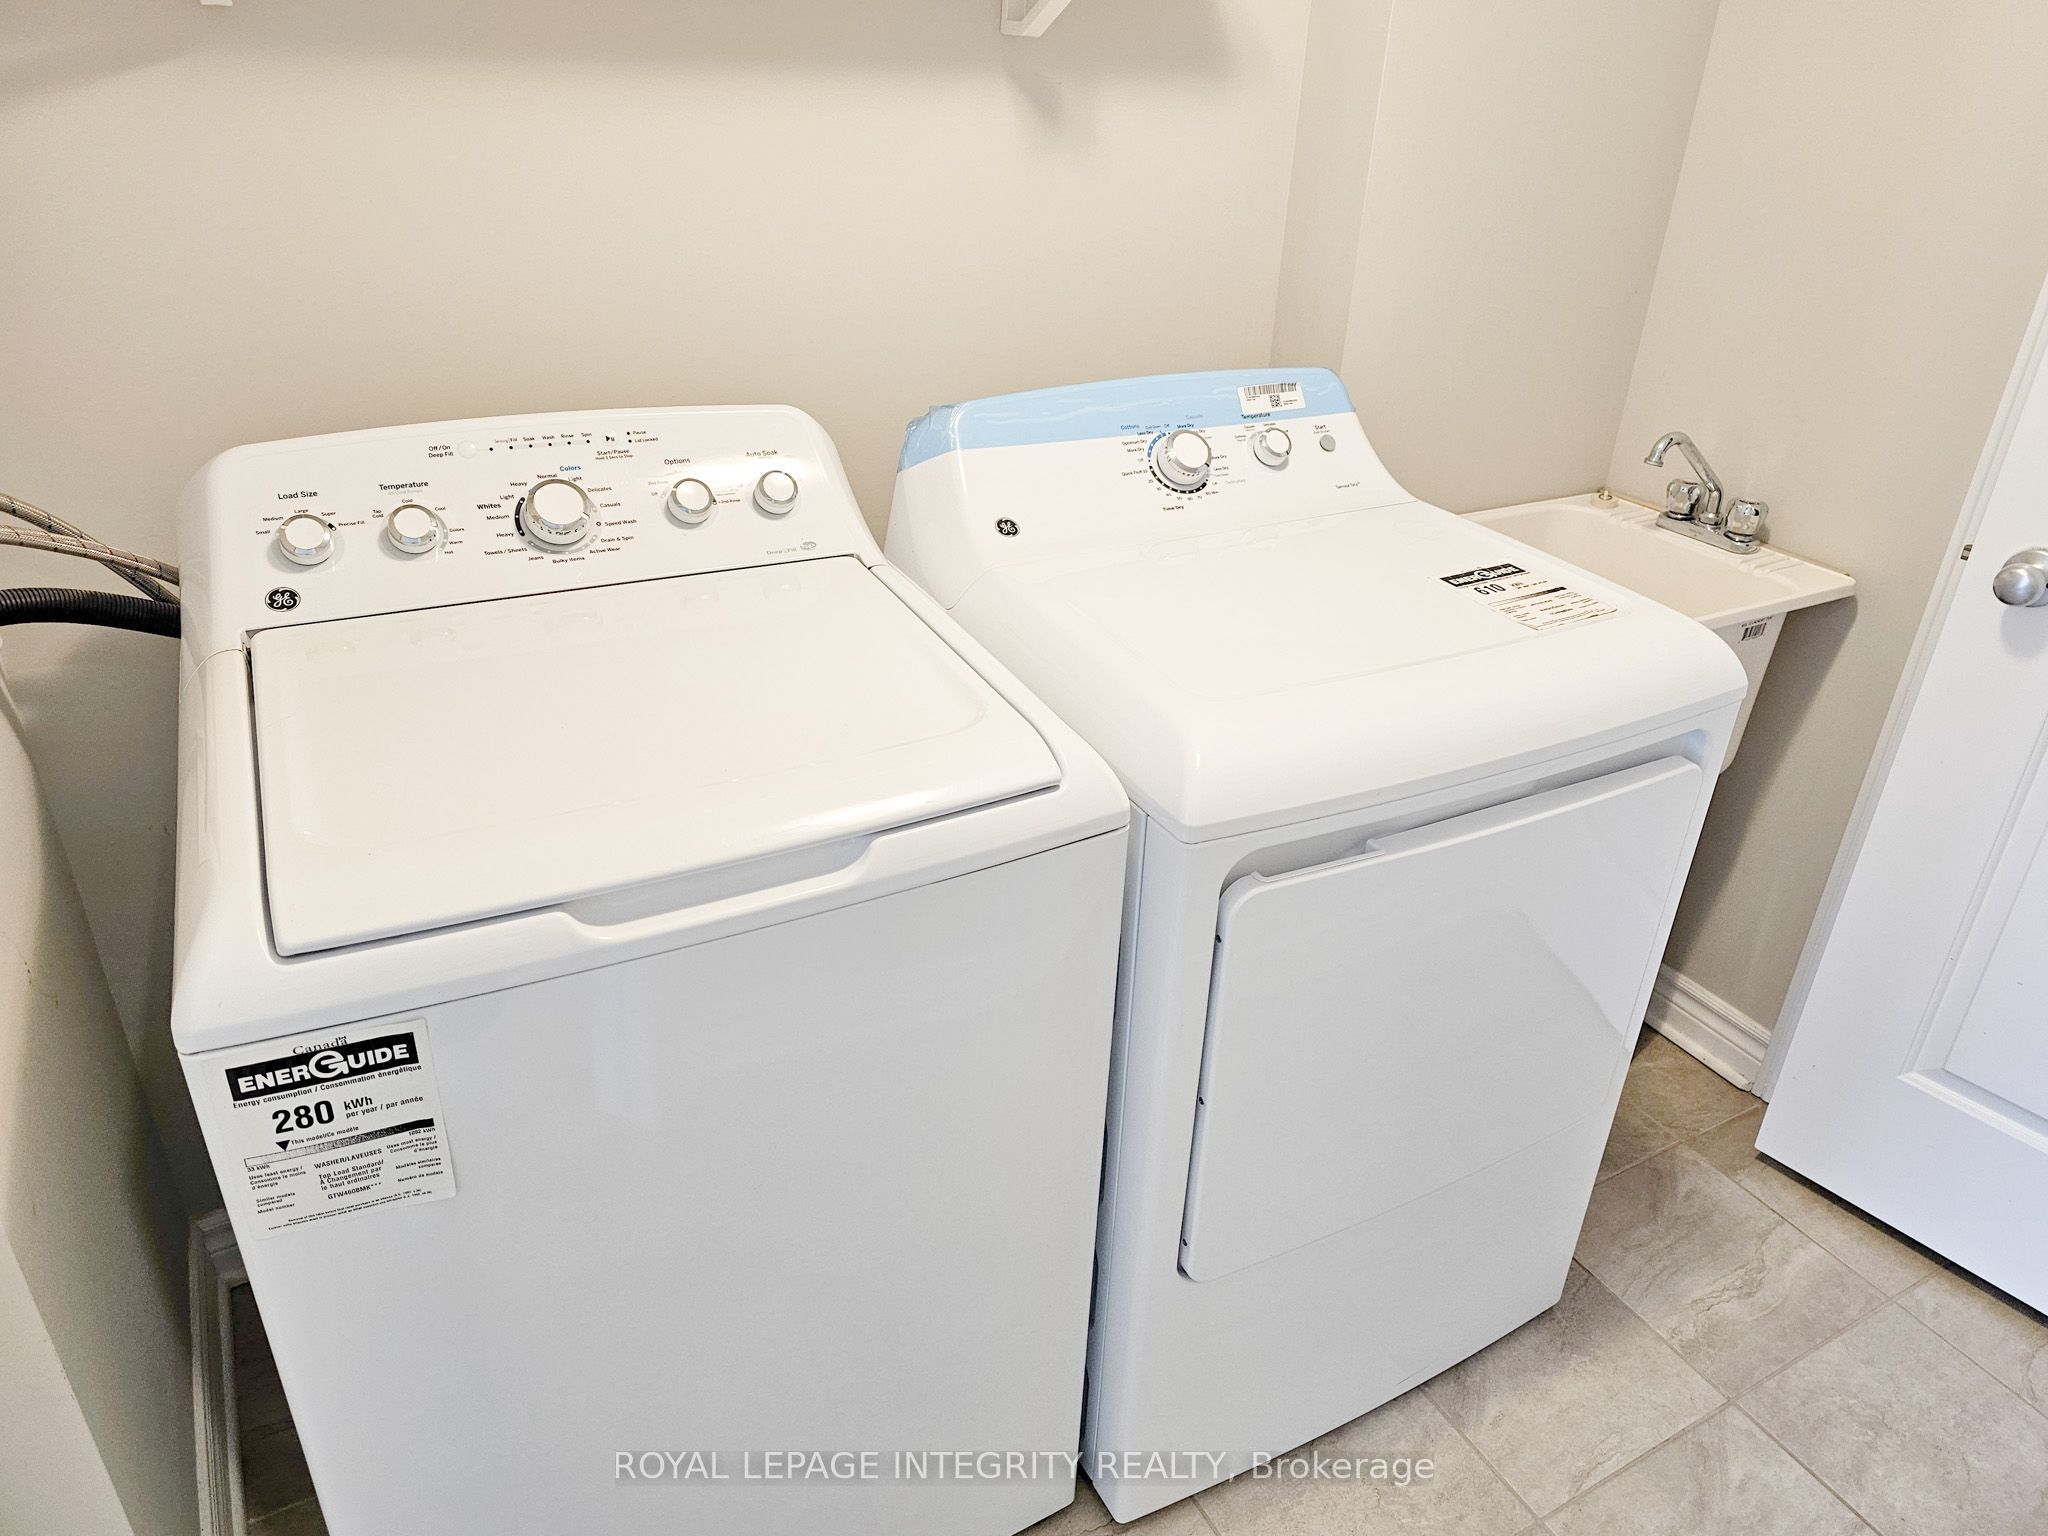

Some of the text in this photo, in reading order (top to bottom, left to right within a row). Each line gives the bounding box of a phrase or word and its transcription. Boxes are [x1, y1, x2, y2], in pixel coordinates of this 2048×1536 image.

[664, 457, 691, 466] Options
[378, 480, 429, 491] Temperature
[277, 490, 319, 500] Load Size
[1473, 584, 1506, 596] 610
[292, 1036, 348, 1055] Canada
[237, 1044, 410, 1093] ENERGUIDE
[233, 1099, 261, 1110] Energy
[263, 1087, 312, 1104] consumption
[321, 1074, 375, 1091] Consommation
[378, 1065, 422, 1079] énergétique
[344, 1096, 373, 1111] kWh
[346, 1111, 359, 1119] per
[361, 1105, 378, 1116] year
[386, 1102, 398, 1110] par
[401, 1096, 424, 1105] année
[272, 1100, 334, 1135] 280
[291, 1138, 305, 1146] This
[314, 1148, 383, 1170] WASHER/LAVEUSES
[249, 1174, 263, 1182] Uses
[264, 1170, 279, 1178] least
[257, 1164, 270, 1172] kWh
[319, 1159, 384, 1180] Top Load Standard/
[327, 1167, 382, 1184] Changement par
[330, 1181, 345, 1189] haut
[346, 1173, 380, 1187] ordinaires
